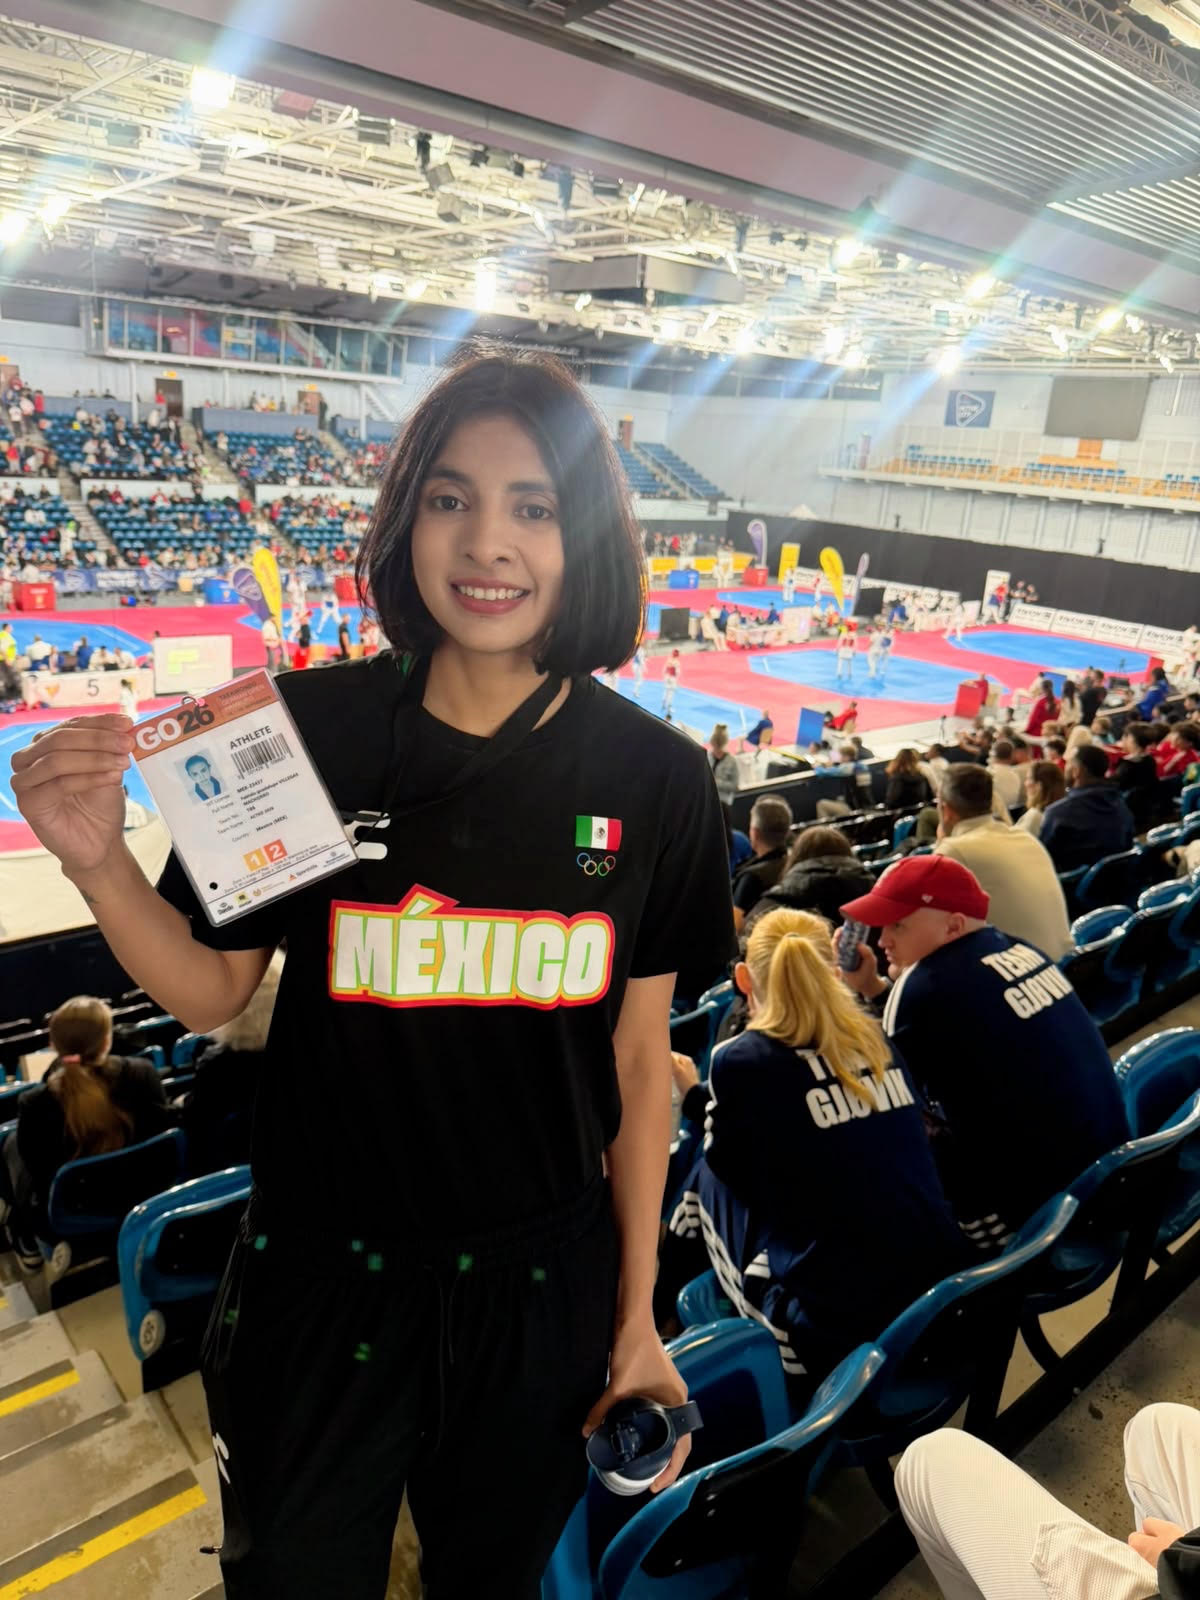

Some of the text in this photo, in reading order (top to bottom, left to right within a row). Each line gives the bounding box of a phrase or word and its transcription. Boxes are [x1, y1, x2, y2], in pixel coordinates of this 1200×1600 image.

[87, 678, 100, 698] 5
[134, 704, 216, 751] GO26
[229, 725, 272, 750] ATHLETE
[333, 893, 610, 1002] MÉXICO
[981, 943, 1046, 982] TEAM
